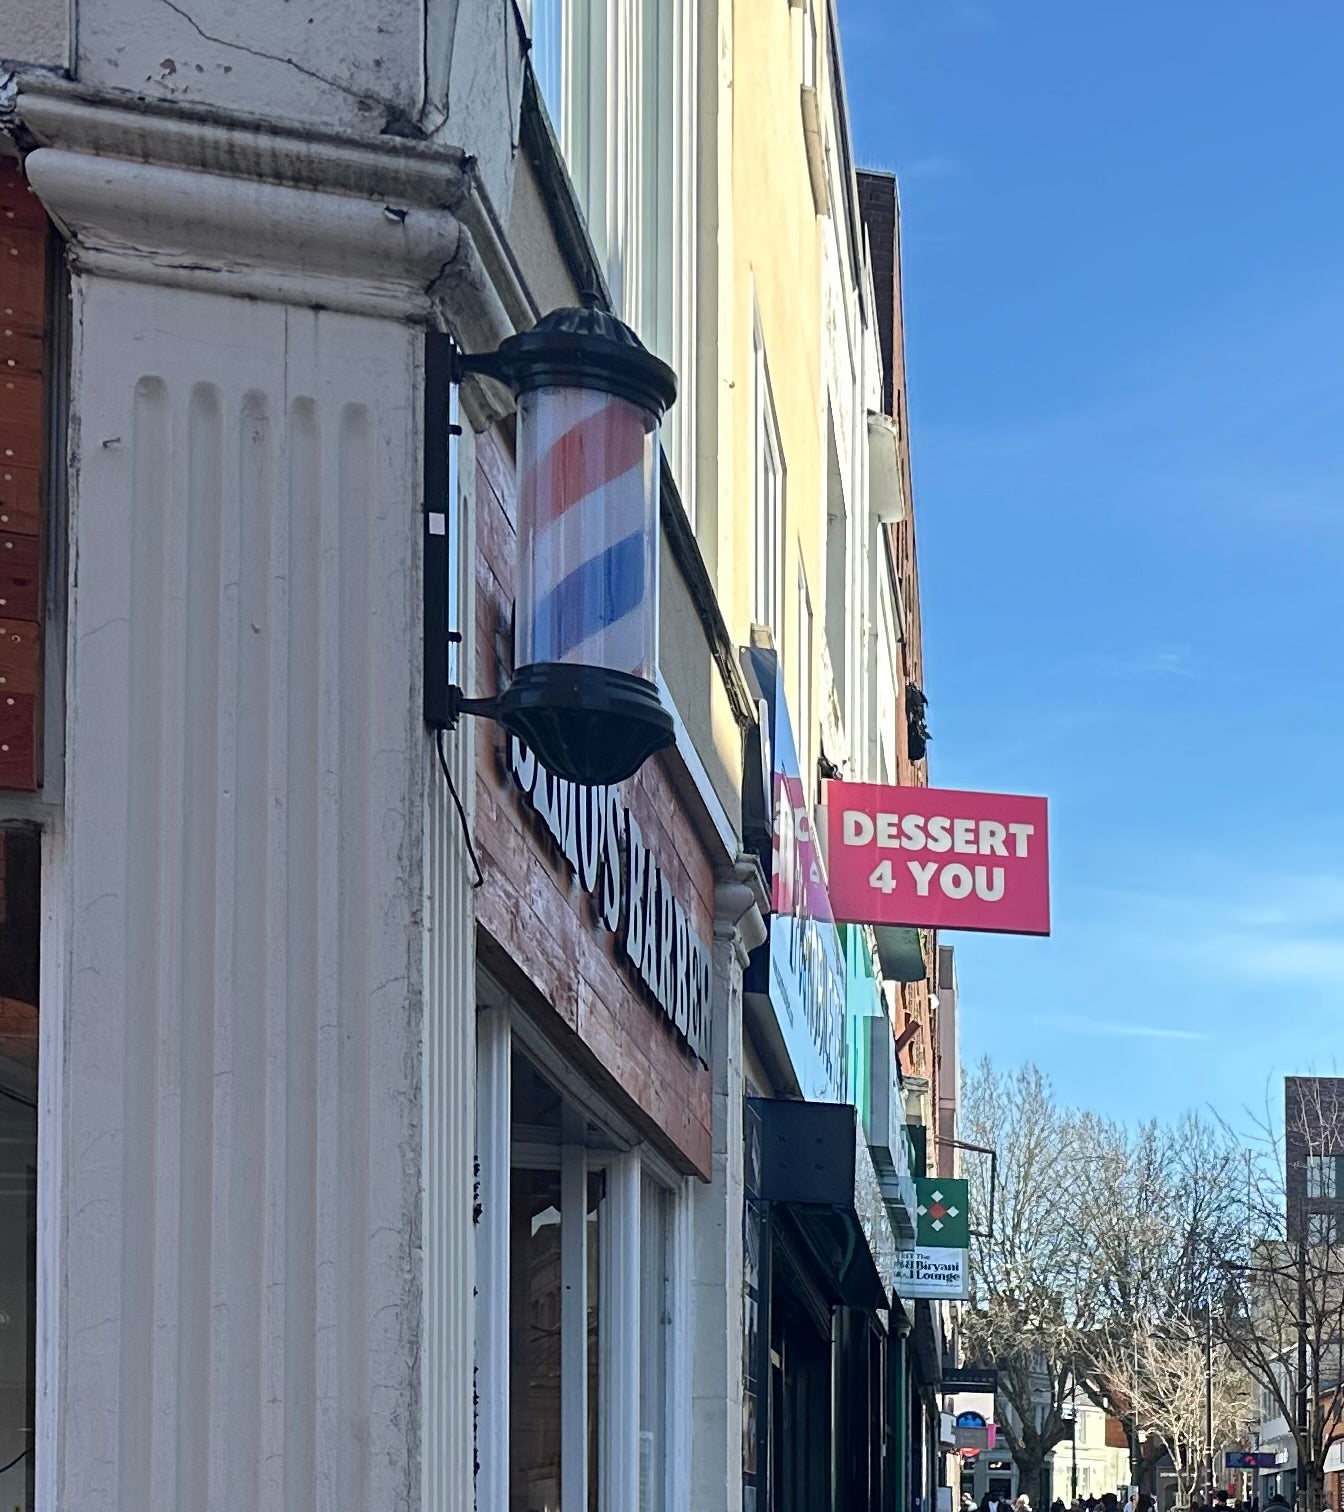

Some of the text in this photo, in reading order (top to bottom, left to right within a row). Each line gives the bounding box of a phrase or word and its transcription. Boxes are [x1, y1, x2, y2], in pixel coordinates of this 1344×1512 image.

[843, 811, 1034, 858] DESSERT
[869, 860, 1005, 902] 4 YOU
[626, 808, 713, 1060] BARBER
[916, 1261, 959, 1271] Biryani
[917, 1270, 960, 1282] Lounge
